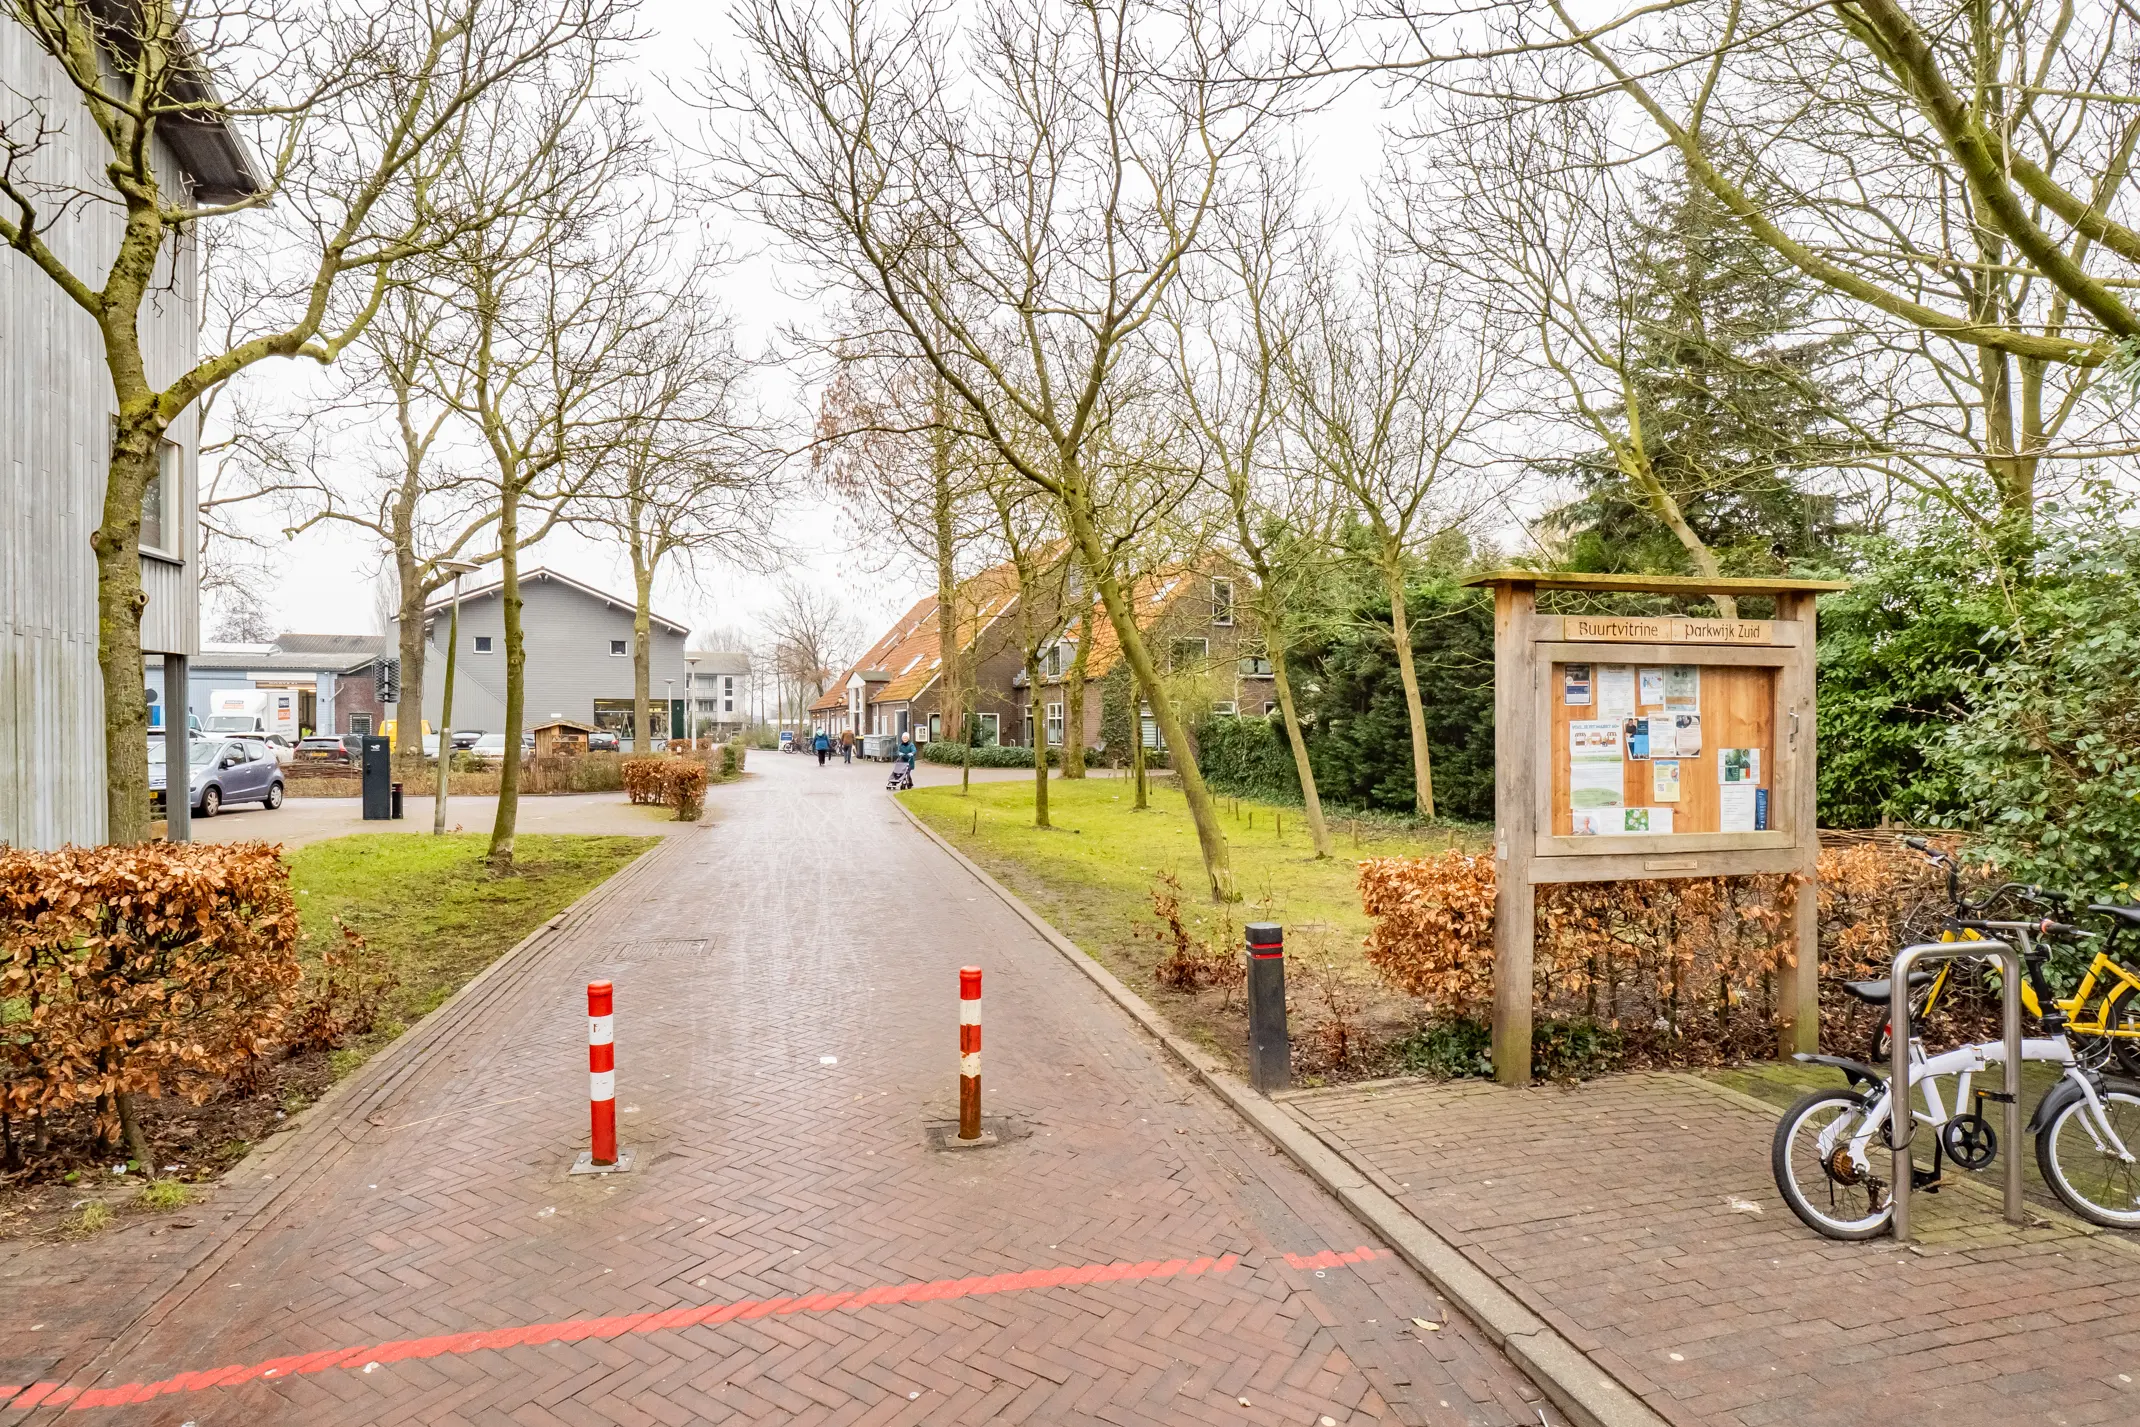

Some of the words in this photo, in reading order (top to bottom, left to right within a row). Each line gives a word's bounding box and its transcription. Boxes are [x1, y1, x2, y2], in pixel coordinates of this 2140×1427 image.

[1579, 620, 1659, 637] Buurtvitrine
[1685, 623, 1735, 641] Parkwijk
[1738, 623, 1760, 639] Zuid
